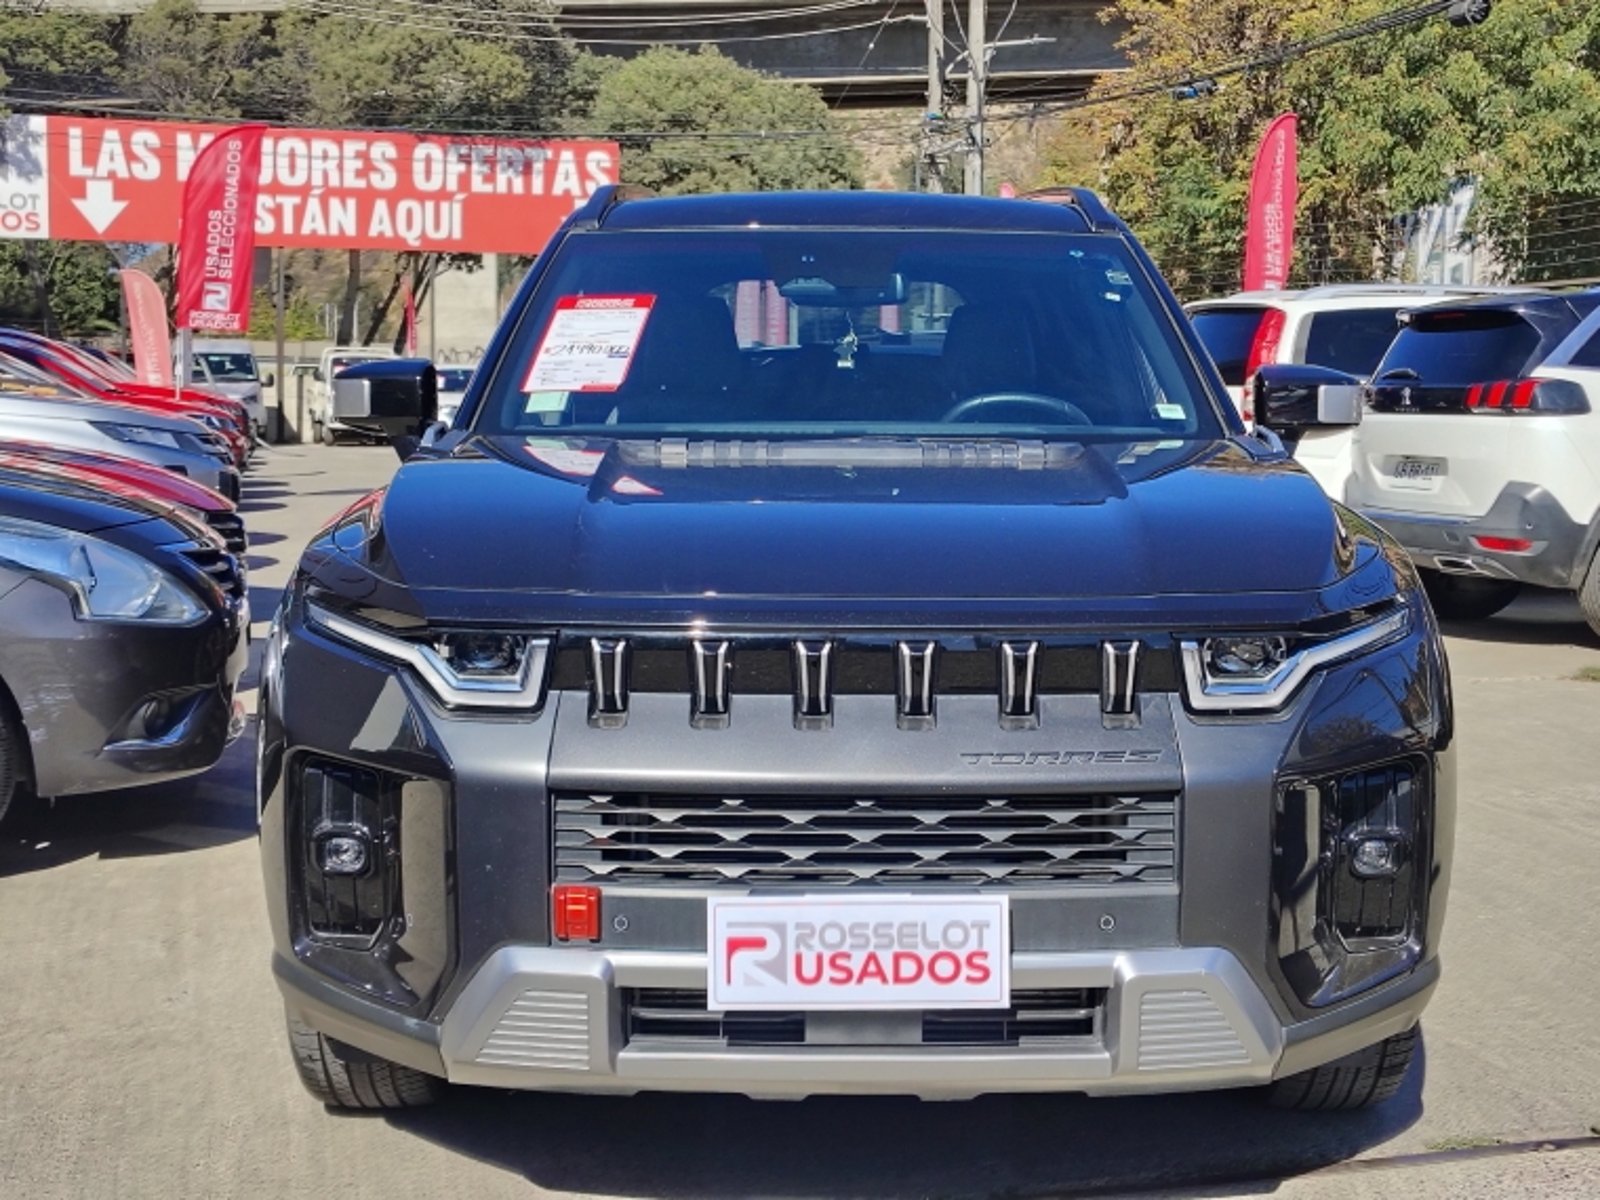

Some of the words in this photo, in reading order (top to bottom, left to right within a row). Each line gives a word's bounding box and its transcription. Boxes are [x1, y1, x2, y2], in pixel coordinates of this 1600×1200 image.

[68, 126, 161, 181] LAS
[175, 130, 398, 190] MJORES
[411, 142, 612, 198] OFERTAS
[218, 139, 243, 279] SELECCIONADOS
[252, 187, 357, 236] STÁN
[368, 193, 468, 247] AQUÍ
[205, 209, 222, 278] USADOS
[960, 750, 1162, 765] TORRES
[794, 920, 991, 951] ROSSELOT
[794, 951, 992, 987] USADOS
